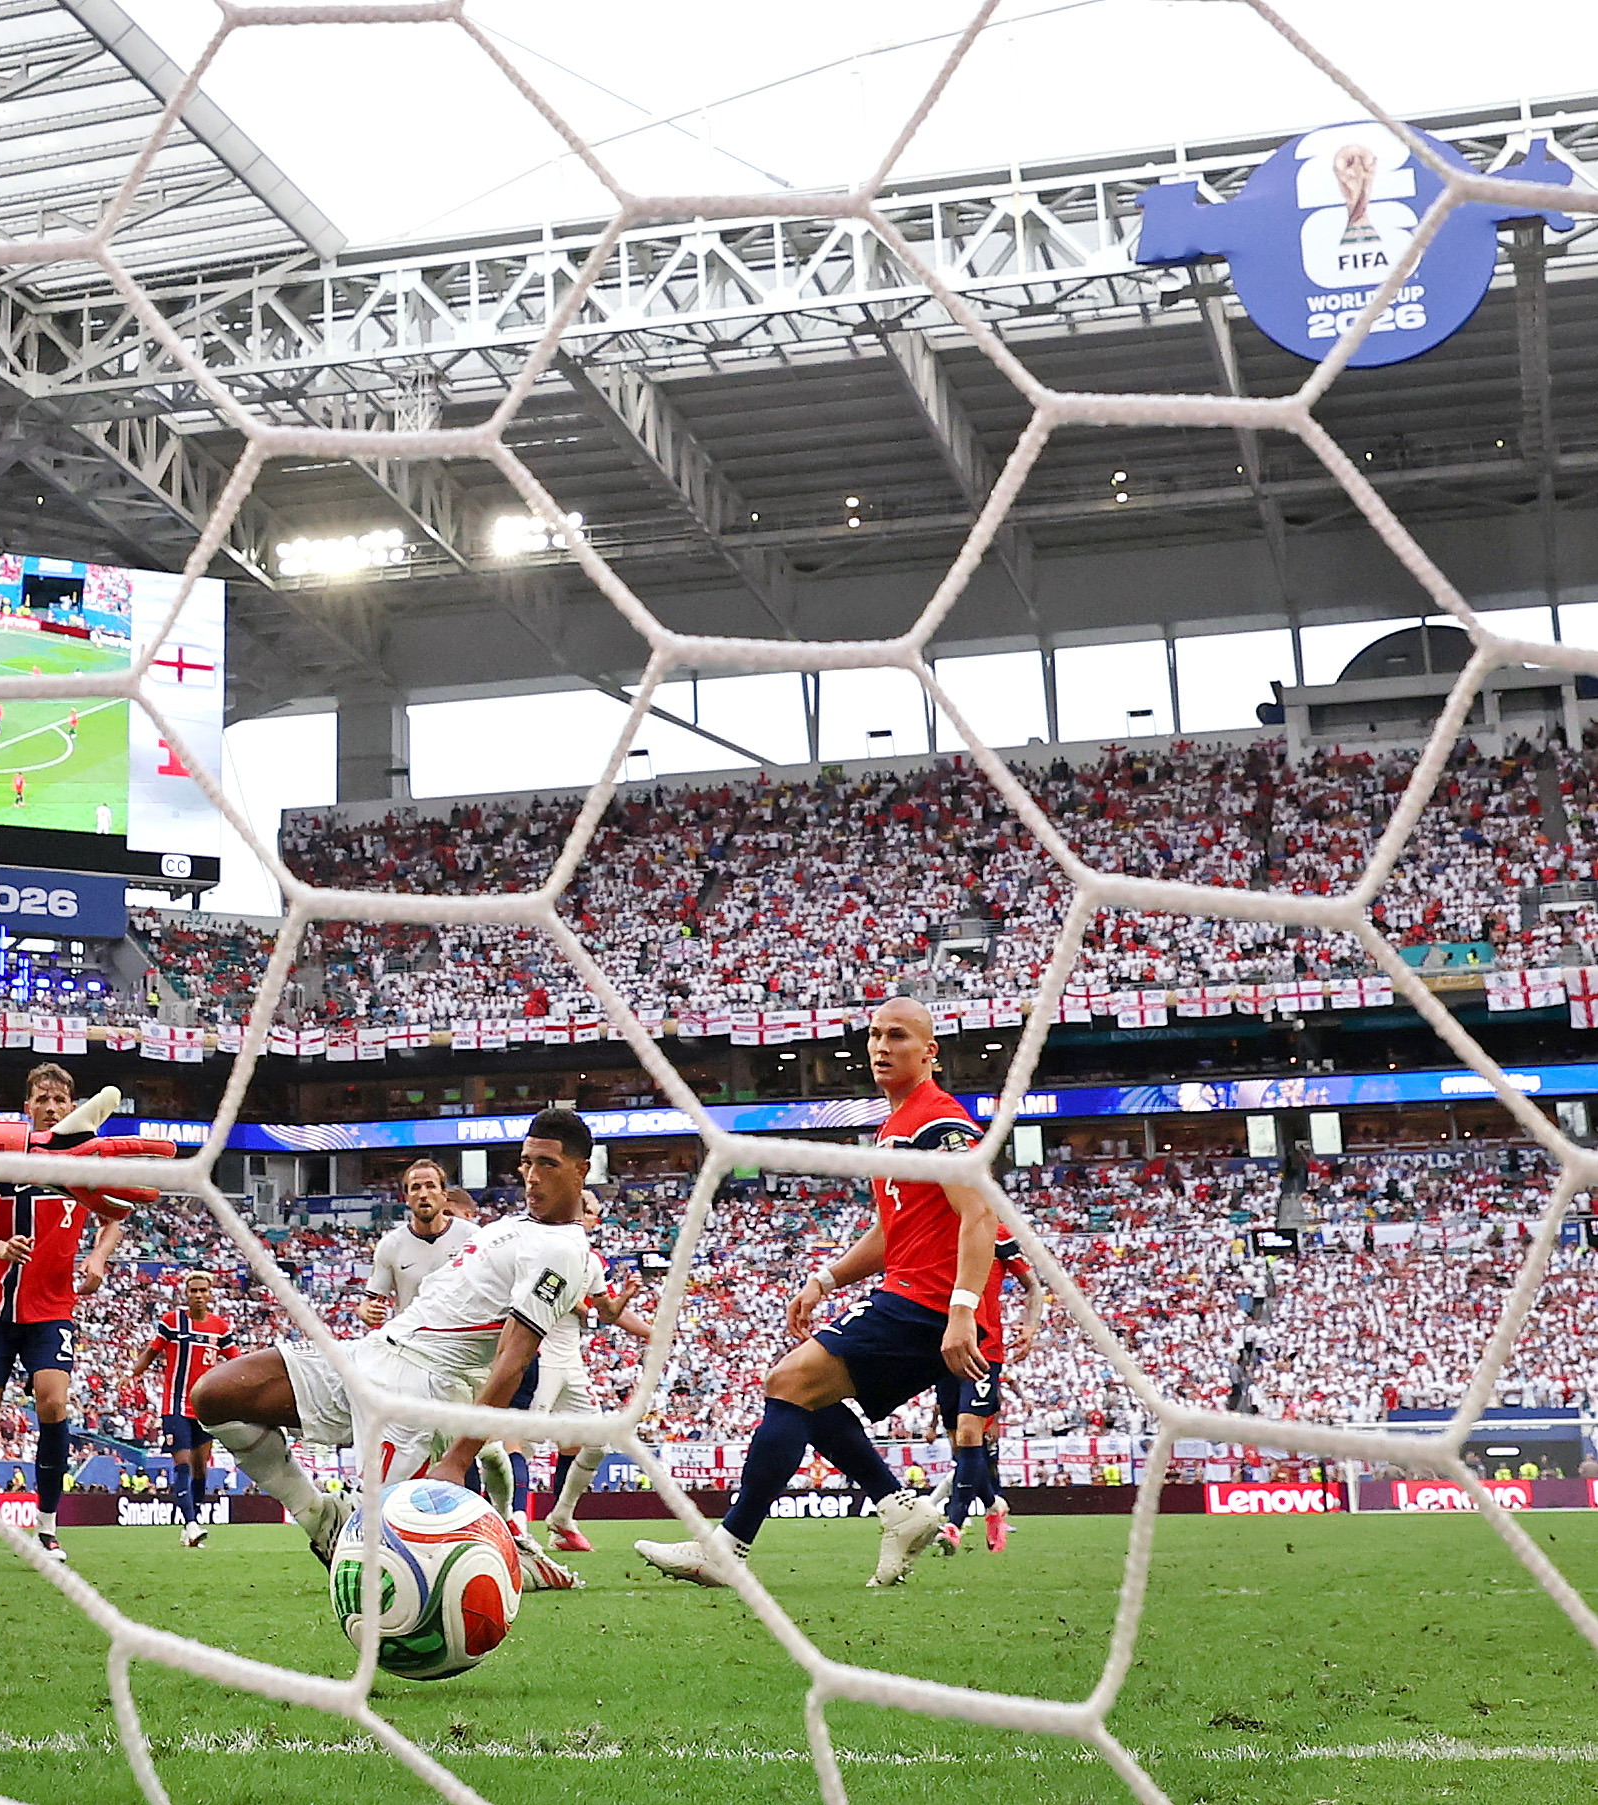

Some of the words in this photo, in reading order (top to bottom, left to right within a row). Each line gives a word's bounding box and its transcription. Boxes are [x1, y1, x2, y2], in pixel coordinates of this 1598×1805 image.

[1338, 252, 1389, 271] FIFA
[1388, 285, 1425, 305] UP
[1307, 303, 1427, 339] 2026
[166, 859, 187, 873] CC
[139, 1122, 210, 1143] MIAMI
[457, 1120, 503, 1141] FIFA
[59, 1199, 78, 1229] 8
[58, 1328, 73, 1355] 8
[608, 1464, 642, 1483] FIF
[1209, 1484, 1334, 1513] Lenovo
[118, 1496, 174, 1526] Smarter
[212, 1496, 230, 1525] all
